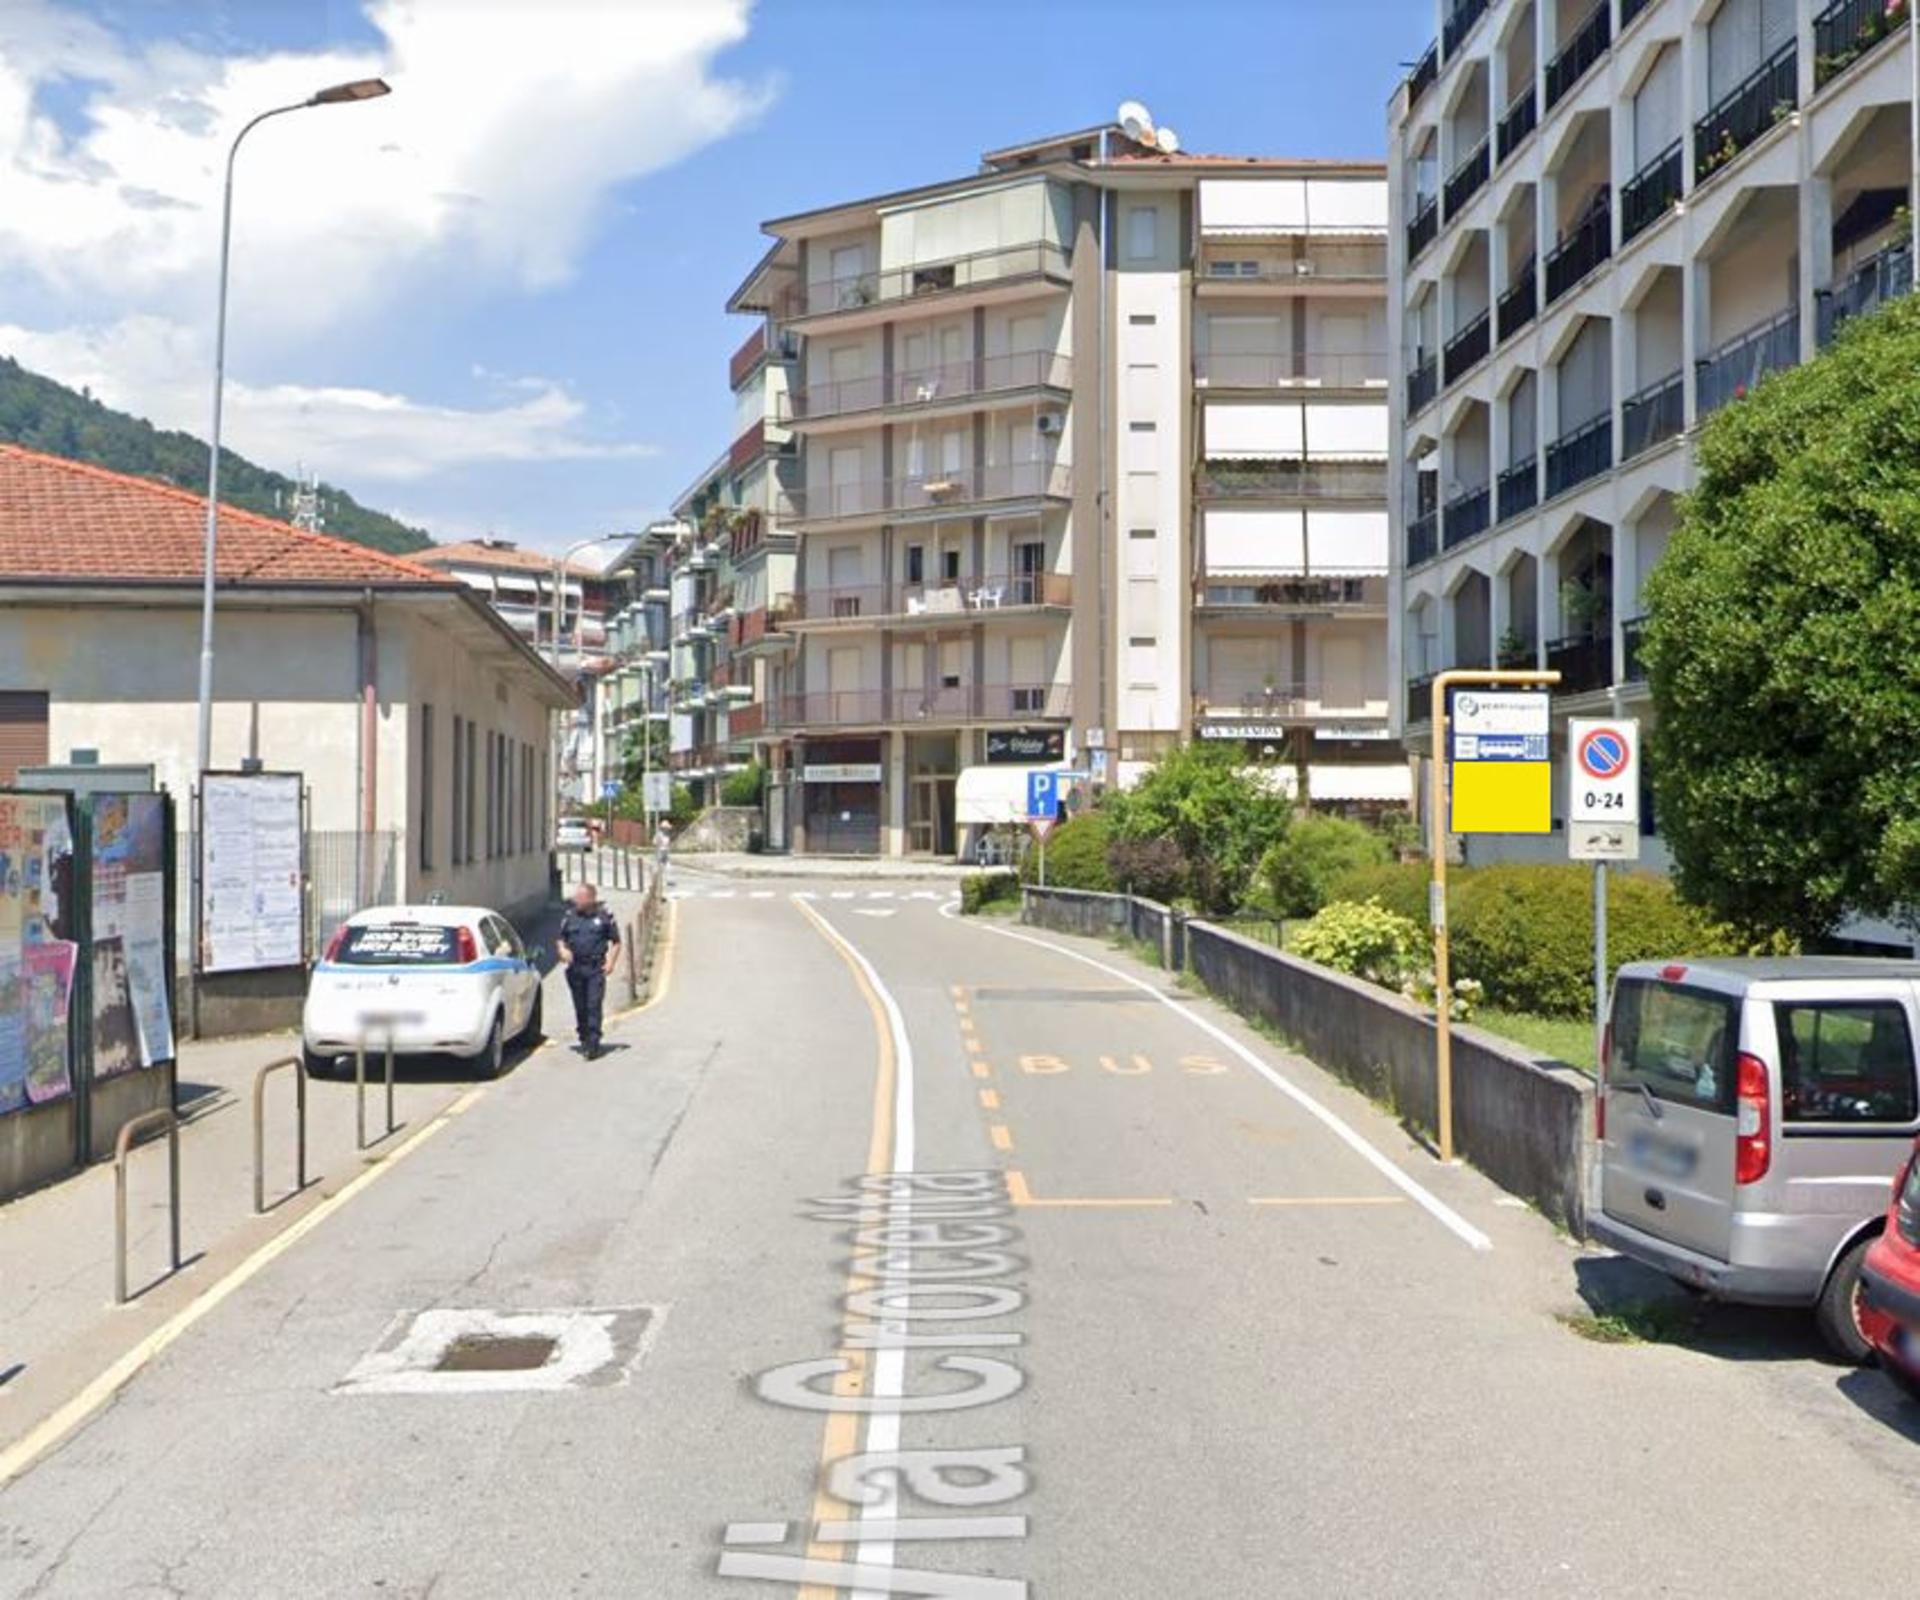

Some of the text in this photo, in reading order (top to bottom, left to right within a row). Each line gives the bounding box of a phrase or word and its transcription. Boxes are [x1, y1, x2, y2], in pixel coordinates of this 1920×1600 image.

[1034, 774, 1051, 799] P
[1585, 792, 1624, 809] 0-24
[1019, 1055, 1228, 1075] BUS
